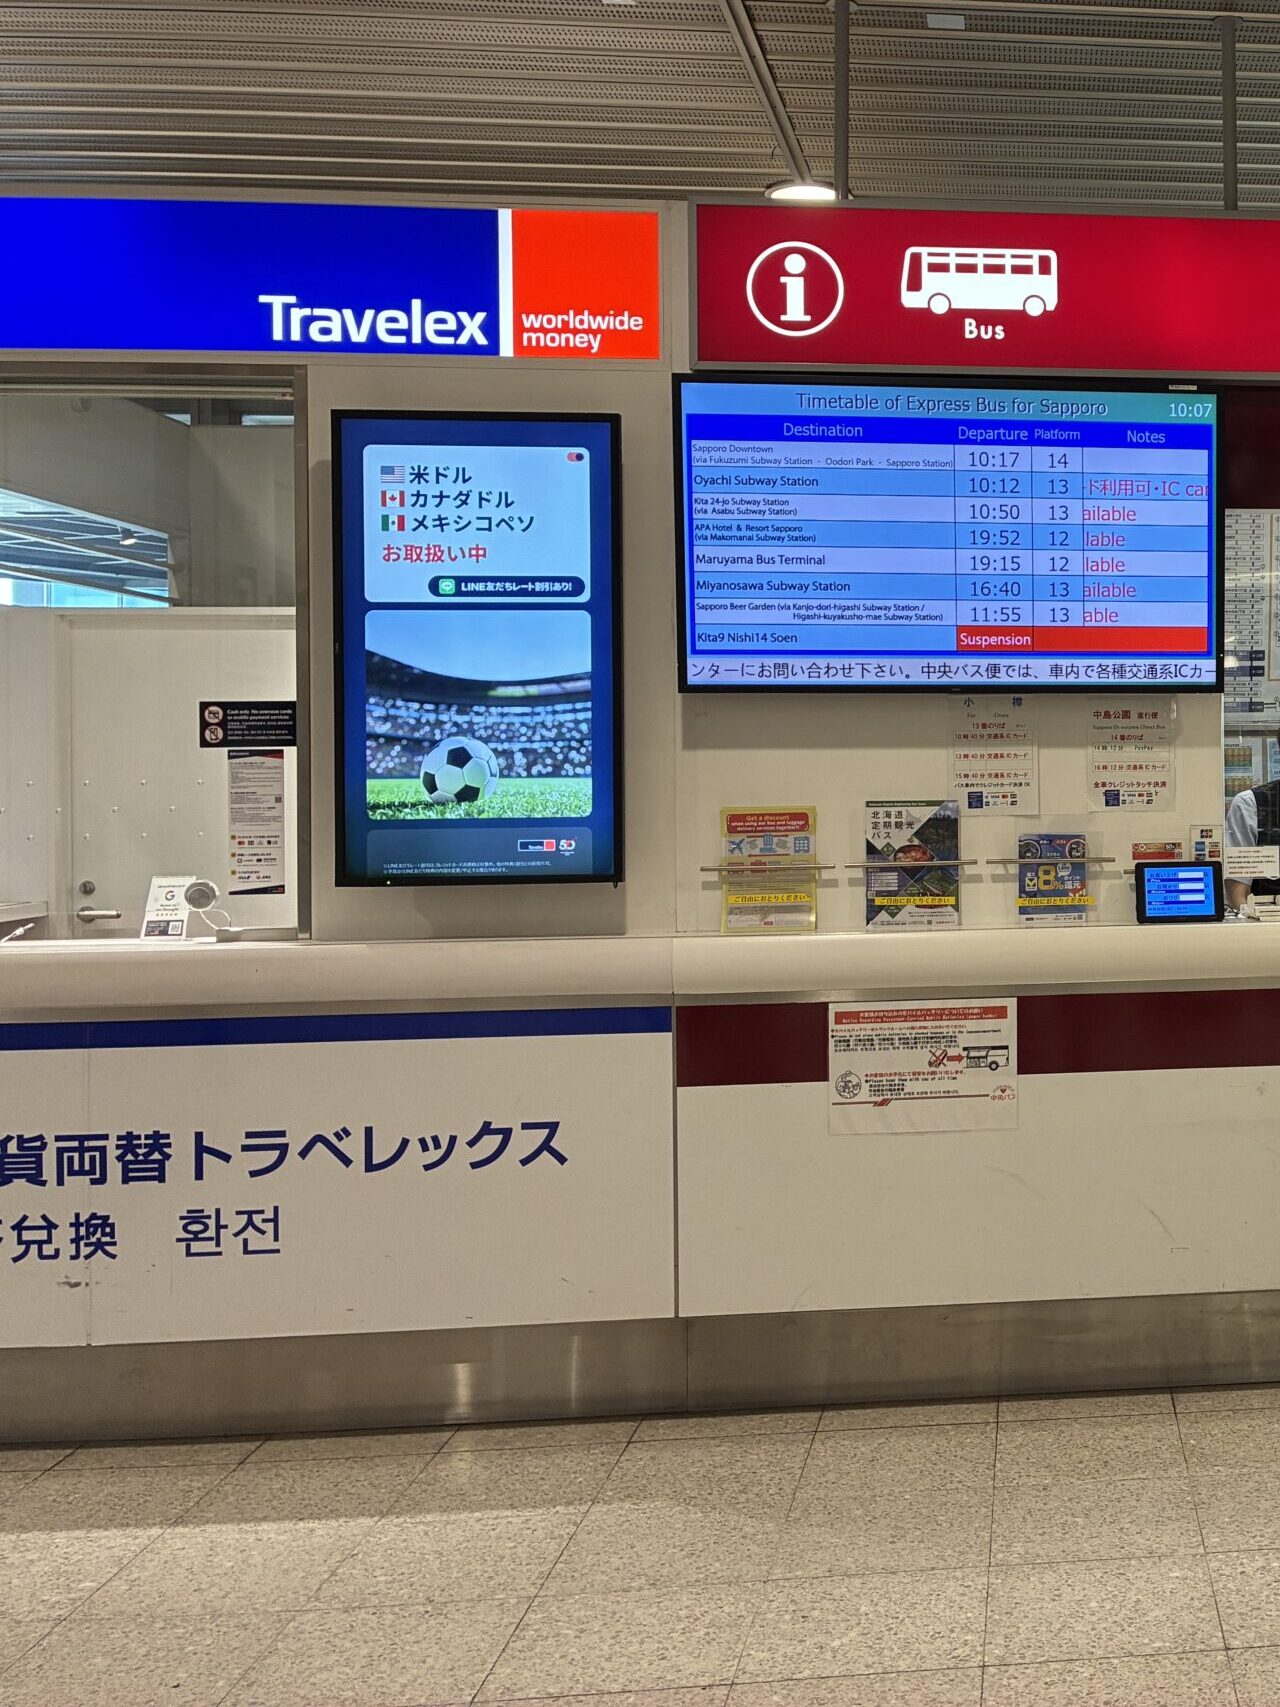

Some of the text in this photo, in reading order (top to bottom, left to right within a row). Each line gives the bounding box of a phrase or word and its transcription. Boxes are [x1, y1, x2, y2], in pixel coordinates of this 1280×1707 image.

[259, 295, 488, 345] Travelex
[522, 311, 643, 331] worldwide
[964, 319, 1005, 340] Bus
[522, 332, 601, 353] money
[796, 393, 1108, 417] Timetable of Express Bus for Sapporo
[1169, 404, 1212, 417] 10:07
[783, 423, 1165, 442] Destination Departure Platform Notes
[693, 444, 773, 453] Sapporo Downtown
[693, 456, 953, 468] (via Fukuzumi Subway Station Oodori Park Sapporo Station)
[969, 452, 1069, 468] 10:17 14
[409, 466, 472, 484] 米ドル
[694, 475, 818, 487] Oyachi Subway Station
[969, 478, 1019, 494] 10:12
[1049, 479, 1069, 494] 13
[1084, 479, 1180, 496] ド利用可・IC
[410, 490, 514, 508] カナダドル
[694, 497, 708, 505] Kita
[732, 498, 760, 507] Subway
[762, 498, 789, 506] Station
[712, 507, 734, 515] Asabu
[737, 508, 766, 517] Subway
[768, 508, 797, 516] Station)
[969, 504, 1020, 520] 10:50
[1049, 505, 1069, 520] 13
[411, 515, 534, 532] メキシコペソ
[695, 524, 710, 532] APA
[712, 524, 732, 532] Hotel
[771, 525, 803, 534] Sapporo
[756, 534, 785, 543] Subway
[787, 535, 816, 543] Station)
[970, 530, 1020, 546] 19:52
[1049, 531, 1069, 546] 12
[382, 544, 487, 563] お取扱い中
[696, 554, 825, 566] Maruyama Bus Terminal
[970, 556, 1020, 571] 19:15
[1049, 557, 1069, 572] 12
[696, 581, 850, 593] Miyanosawa Subway Station
[970, 582, 1021, 597] 16:40
[1050, 583, 1069, 598] 13
[697, 602, 728, 612] Sapporo
[730, 603, 746, 611] Beer
[748, 603, 776, 611] Garden
[862, 604, 891, 613] Subway
[894, 604, 919, 612] Station
[971, 607, 1021, 622] 11:55
[1050, 608, 1069, 623] 13
[884, 613, 912, 622] Subway
[914, 613, 943, 622] Station)
[697, 632, 797, 643] Kita9 Nishi14 Soen
[960, 633, 1031, 647] Suspension
[872, 811, 903, 819] 北海道
[0, 1212, 118, 1264] 兌換
[175, 1205, 282, 1259] 환전
